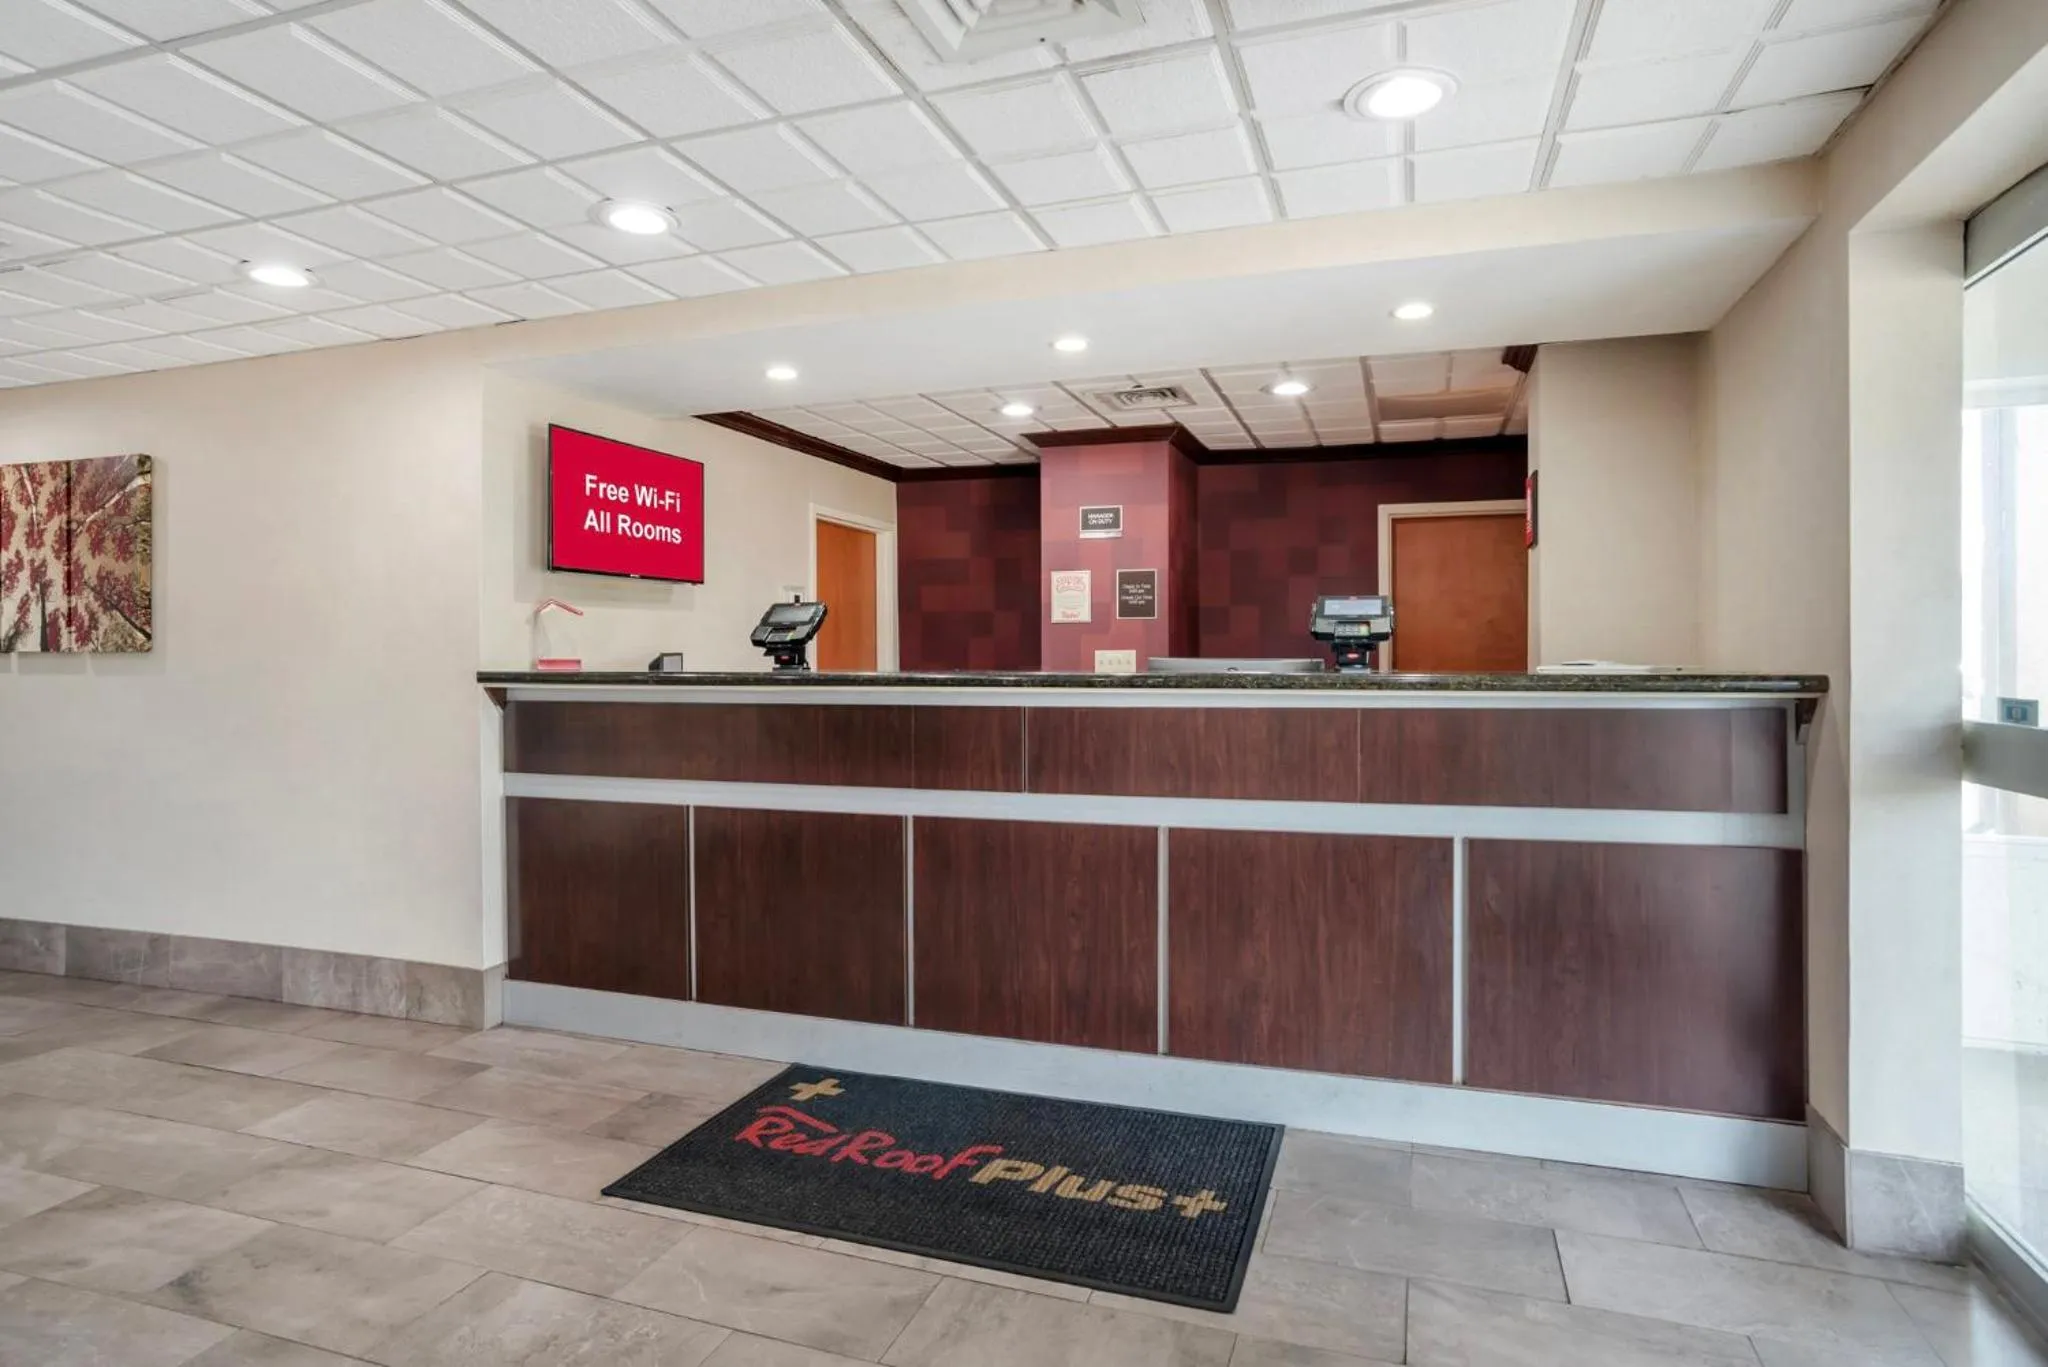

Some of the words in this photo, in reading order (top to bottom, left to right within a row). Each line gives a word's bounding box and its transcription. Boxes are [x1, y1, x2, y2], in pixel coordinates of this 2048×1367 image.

[585, 474, 630, 503] Free
[634, 483, 681, 513] Wi-Fi
[584, 508, 611, 533] All
[617, 514, 682, 545] Rooms
